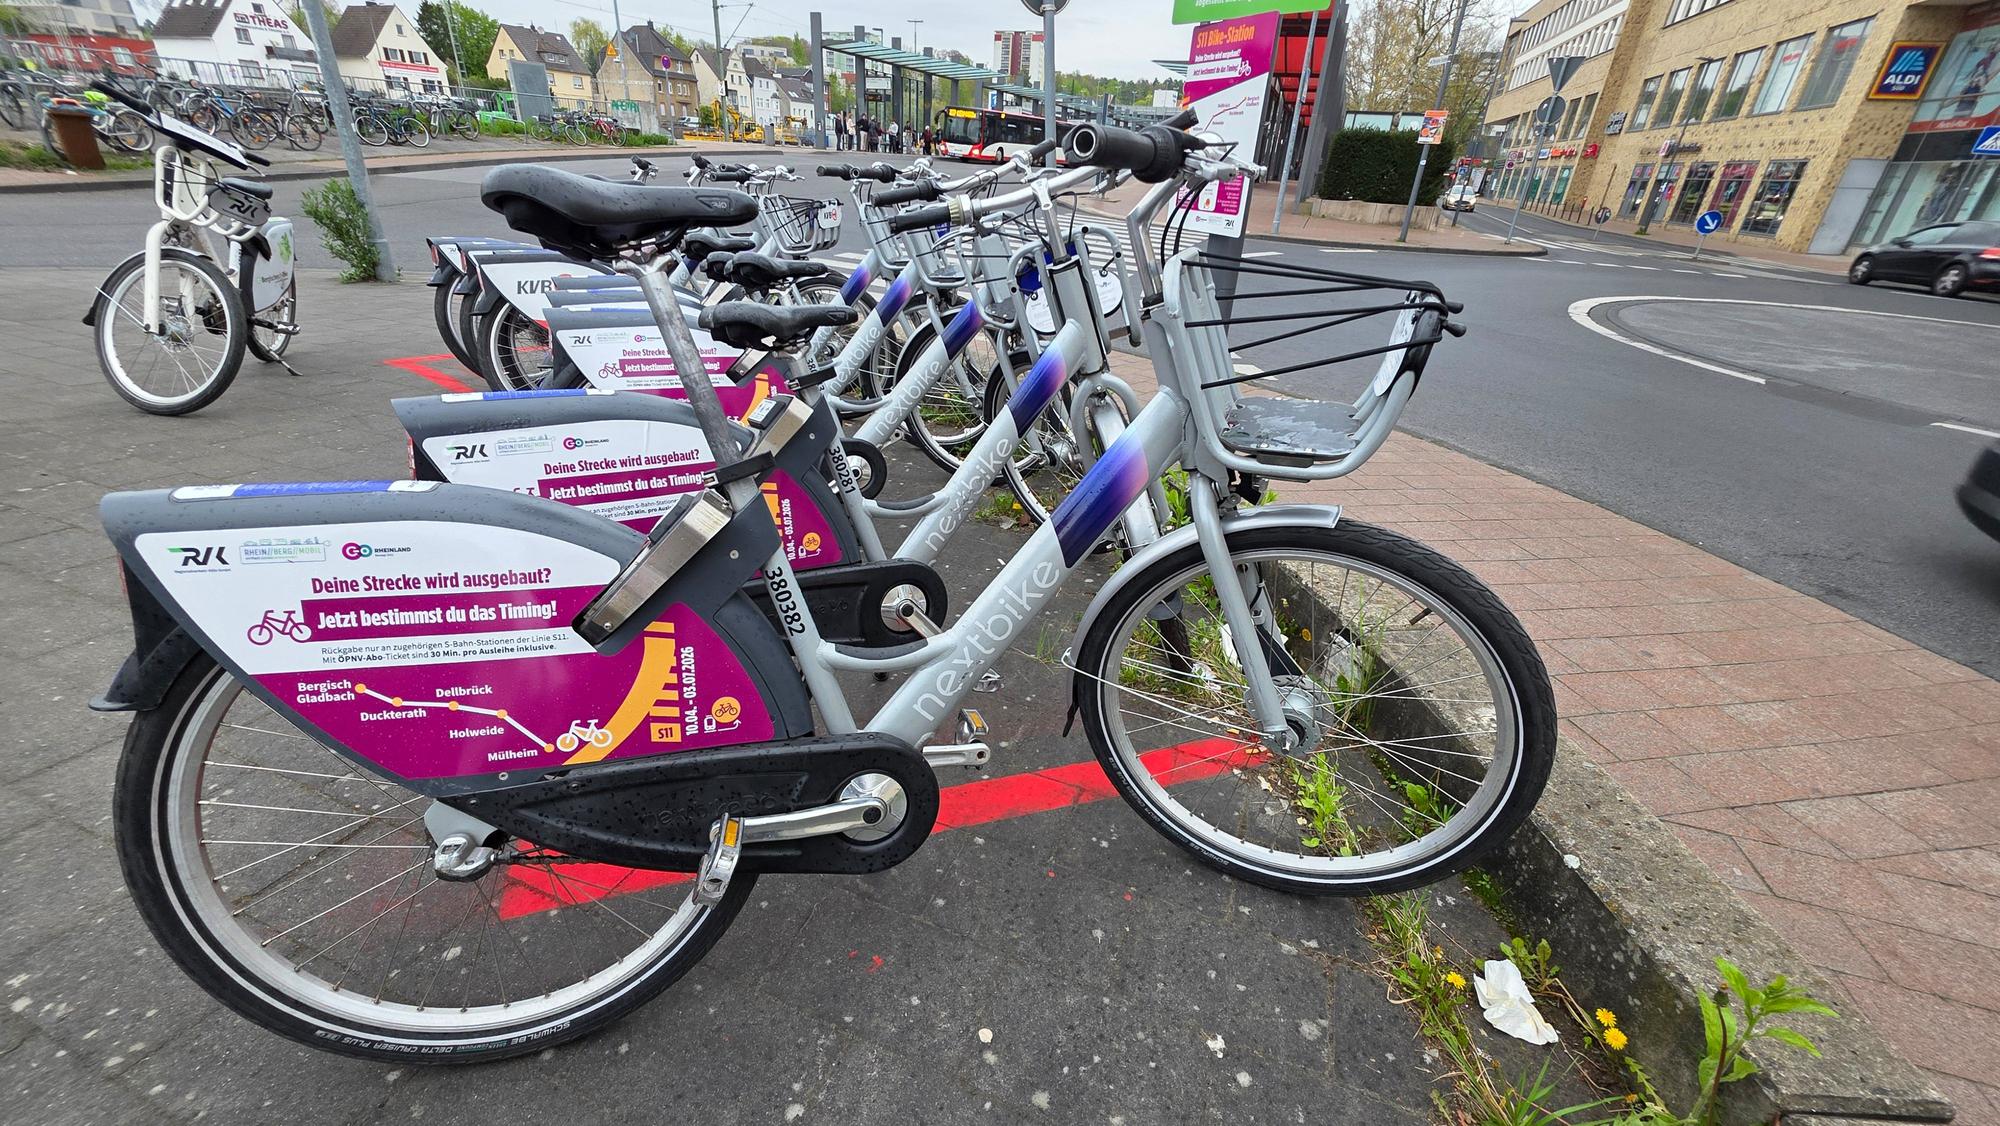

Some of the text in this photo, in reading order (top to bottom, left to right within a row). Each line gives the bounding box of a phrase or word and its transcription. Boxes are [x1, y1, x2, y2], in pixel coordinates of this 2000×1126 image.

[250, 15, 288, 30] THEAS
[1196, 24, 1255, 48] S11 Bike-Station
[1883, 75, 1921, 85] ALDI
[517, 280, 552, 294] KVB
[623, 348, 641, 357] Deine
[642, 348, 665, 356] Strecke
[829, 326, 881, 394] nextbike
[625, 363, 640, 372] Jetzt
[640, 363, 675, 371] bestimmst
[875, 359, 943, 437] nextbike
[544, 449, 700, 475] Deine Strecke wird ausgebaut?
[829, 446, 857, 494] 380281
[549, 471, 705, 500] Jetzt bestimmst du das Timing!
[925, 438, 1012, 551] nextbike
[780, 498, 794, 535] 03.07.2026
[787, 539, 797, 561] 10.04.
[311, 568, 552, 594] Deine Strecke wird ausgebaut?
[765, 566, 806, 637] 380382
[318, 601, 557, 629] Jetzt bestimmst du das Timing!
[321, 645, 363, 656] Rückgabe
[393, 641, 443, 653] zugehörigen
[444, 637, 514, 648] S-Bahn-Stationen
[516, 636, 530, 644] der
[532, 634, 550, 643] Linie
[552, 633, 569, 642] S11.
[912, 561, 1060, 722] nextbike
[322, 656, 336, 664] Mit
[337, 651, 410, 663] ÖPNV-Abo-Ticket
[411, 651, 429, 659] sind
[443, 649, 461, 657] Min.
[463, 648, 477, 657] pro
[478, 646, 515, 655] Ausleihe
[516, 643, 557, 652] inklusive.
[680, 646, 697, 699] 03.07.2026
[296, 691, 355, 704] Gladbach
[297, 680, 352, 693] Bergisch
[435, 684, 493, 698] Dellbrück
[360, 708, 427, 722] Duckterath
[683, 706, 698, 736] 10.04.
[449, 725, 505, 739] Holweide
[657, 727, 673, 740] S11
[487, 748, 538, 762] Mülheim
[343, 1036, 372, 1049] PLUS
[510, 1021, 570, 1045] SCHWALBE
[373, 1041, 417, 1053] CRUISER
[422, 1045, 453, 1053] DELTA
